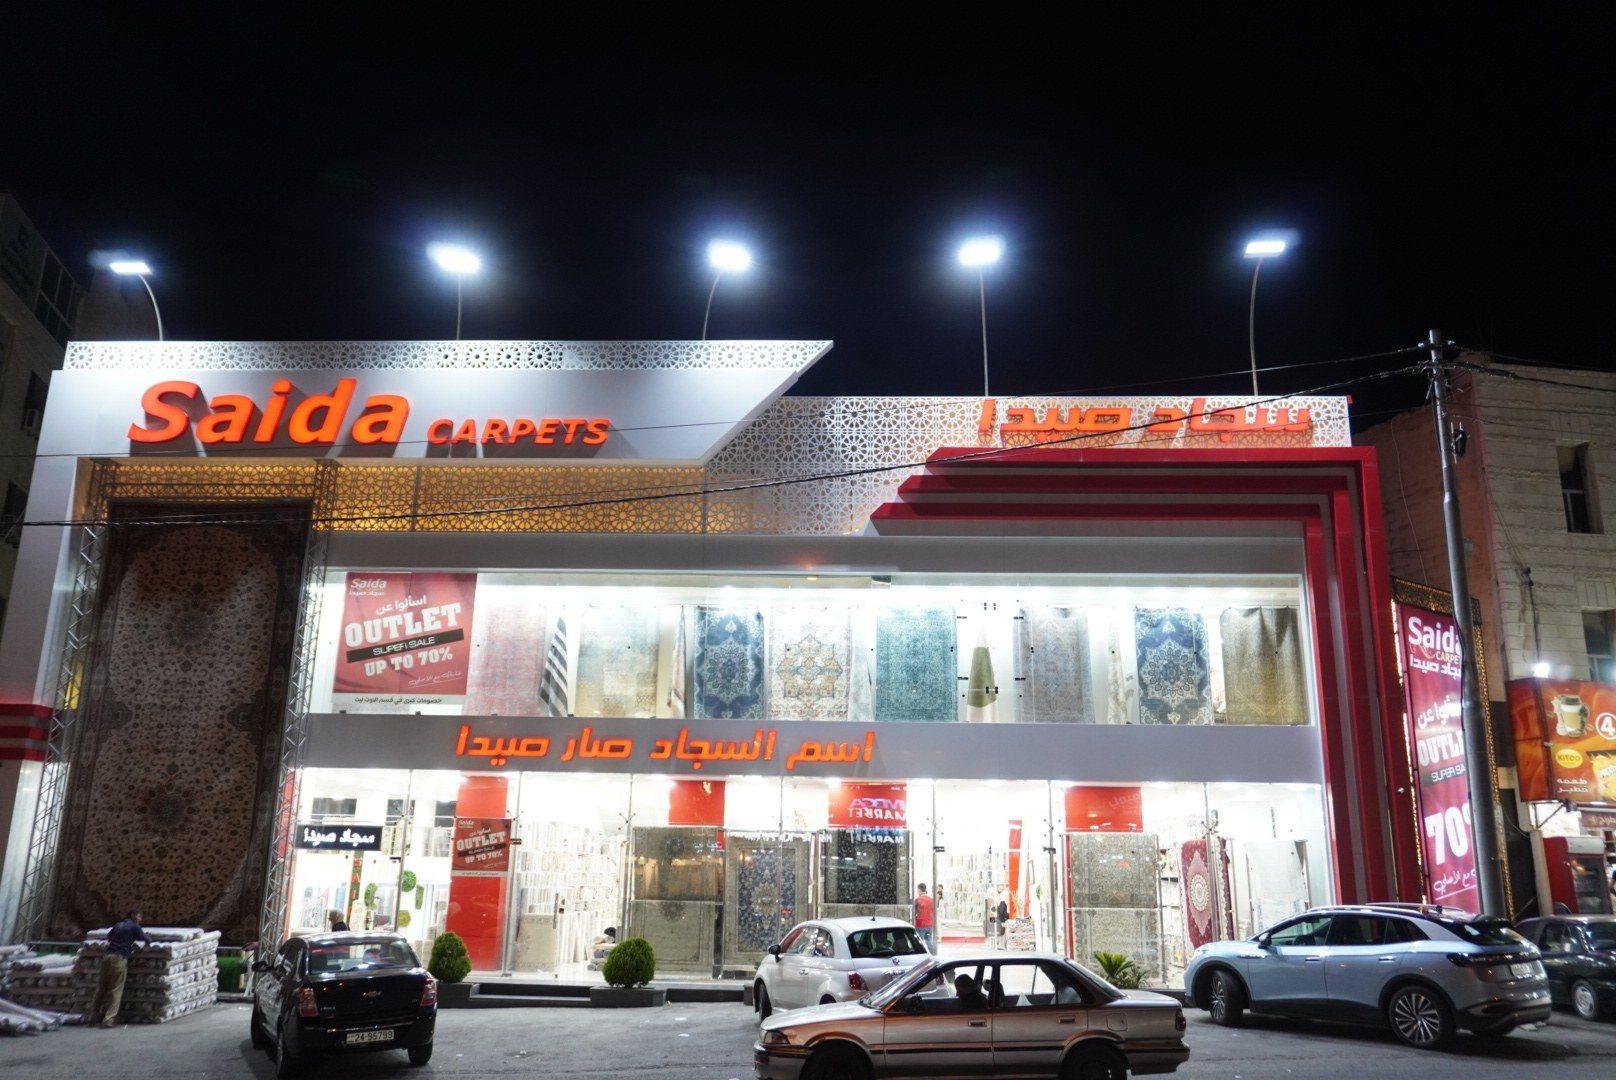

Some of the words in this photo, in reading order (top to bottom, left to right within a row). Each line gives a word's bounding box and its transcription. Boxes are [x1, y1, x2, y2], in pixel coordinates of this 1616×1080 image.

[127, 378, 411, 444] Saida
[426, 418, 612, 446] CARPETS
[979, 397, 1133, 442] صيدا
[1149, 397, 1310, 443] سجاد
[350, 578, 388, 590] Saida
[375, 603, 394, 616] عن
[394, 594, 428, 613] اسألوا
[344, 602, 462, 648] OUTLET
[372, 642, 408, 656] SUPER
[408, 636, 436, 649] SALE
[364, 659, 388, 677] UP
[390, 654, 414, 671] TO
[417, 646, 454, 667] 70%
[1409, 653, 1440, 675] صيدا
[1435, 650, 1462, 666] CARPE
[1441, 662, 1462, 680] جاد
[1418, 708, 1435, 730] عن
[1600, 715, 1616, 737] 4
[455, 725, 550, 766] صيدا
[559, 726, 634, 762] صار
[649, 726, 777, 770] السجاد
[785, 728, 875, 771] اسم
[1417, 730, 1464, 767] OUTL
[1431, 765, 1456, 783] SUPER
[1454, 763, 1467, 776] SA
[303, 826, 337, 847] صيدا
[339, 827, 375, 848] سجاد
[456, 831, 506, 851] OUTLET
[464, 855, 475, 864] UP
[475, 853, 487, 861] TO
